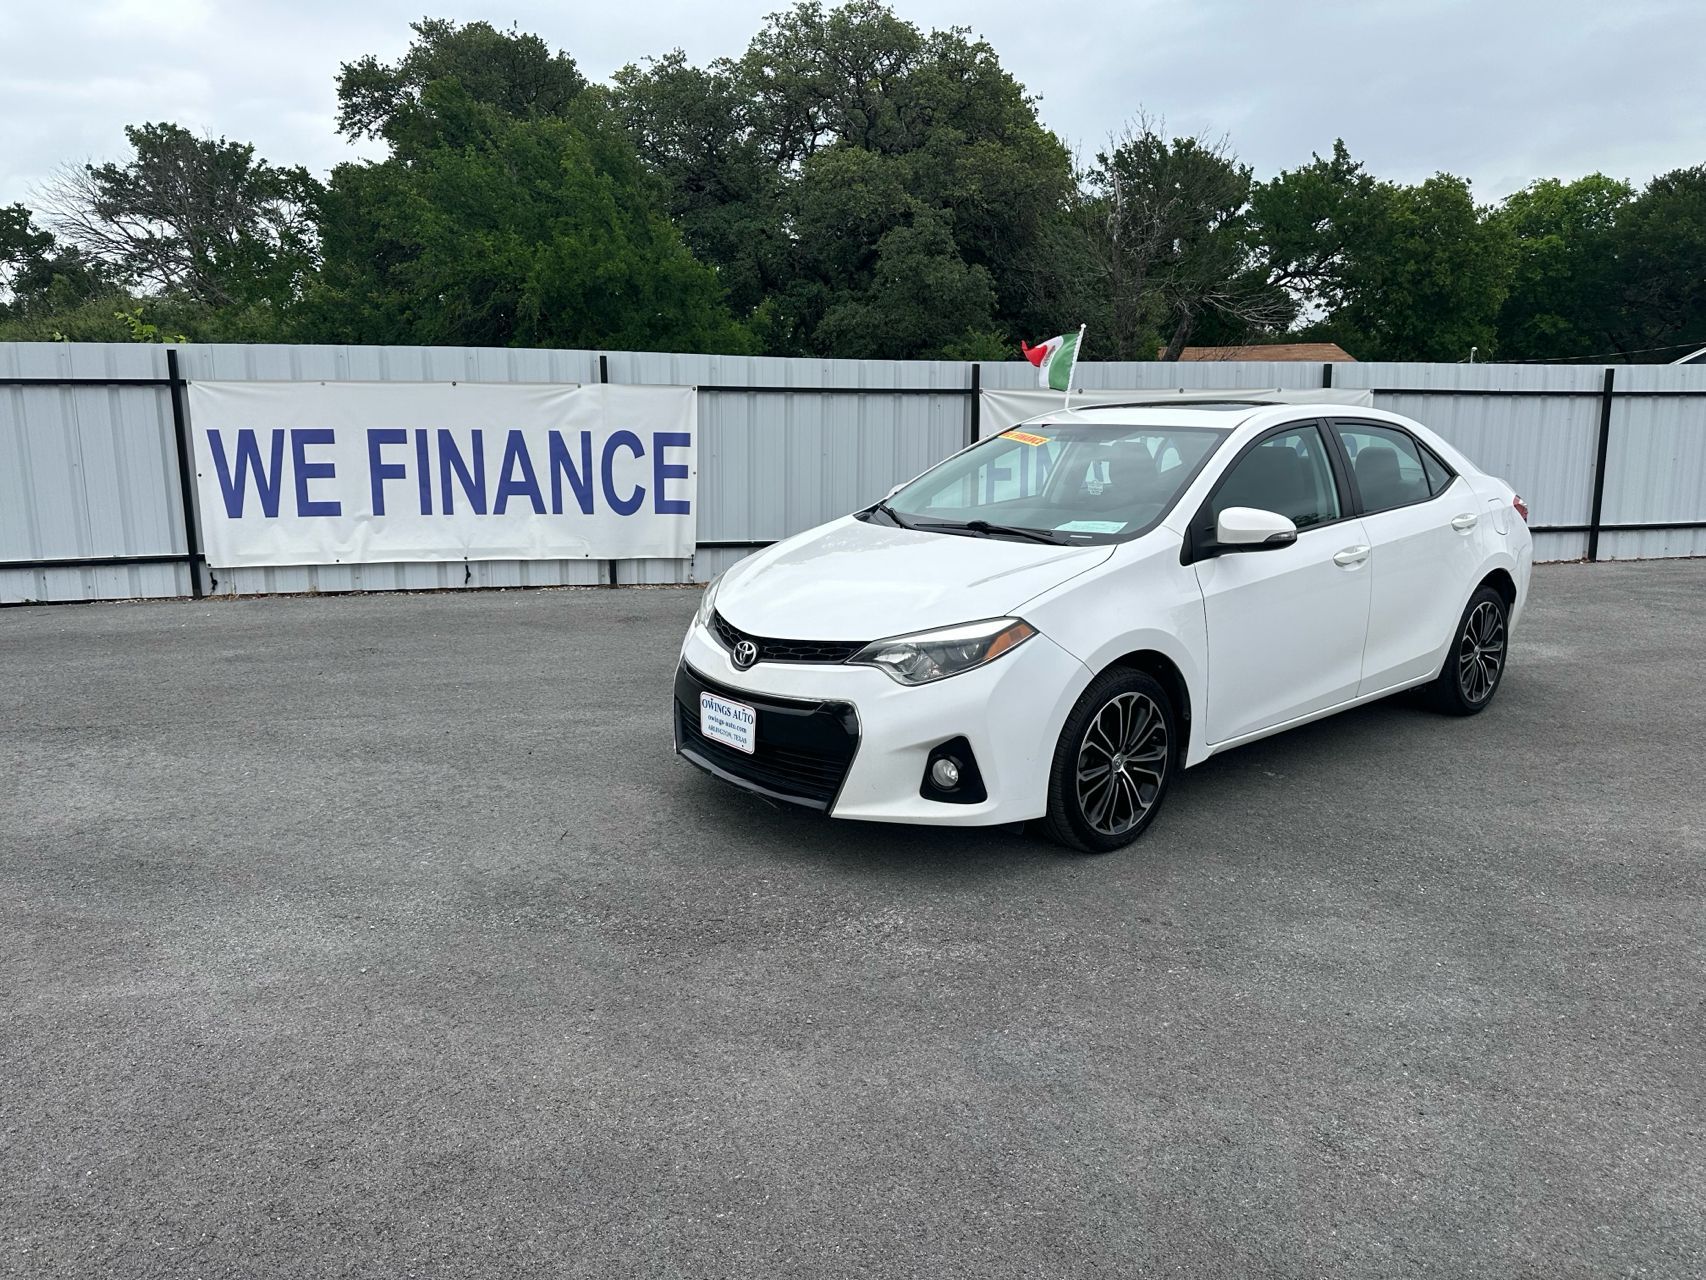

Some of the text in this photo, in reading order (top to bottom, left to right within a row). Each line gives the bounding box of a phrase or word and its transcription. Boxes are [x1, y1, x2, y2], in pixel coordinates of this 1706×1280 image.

[206, 428, 691, 519] WE FINANCE
[702, 699, 753, 724] OWINGS AUTO
[708, 715, 747, 733] owings-auto.com
[733, 734, 747, 744] TEXAS
